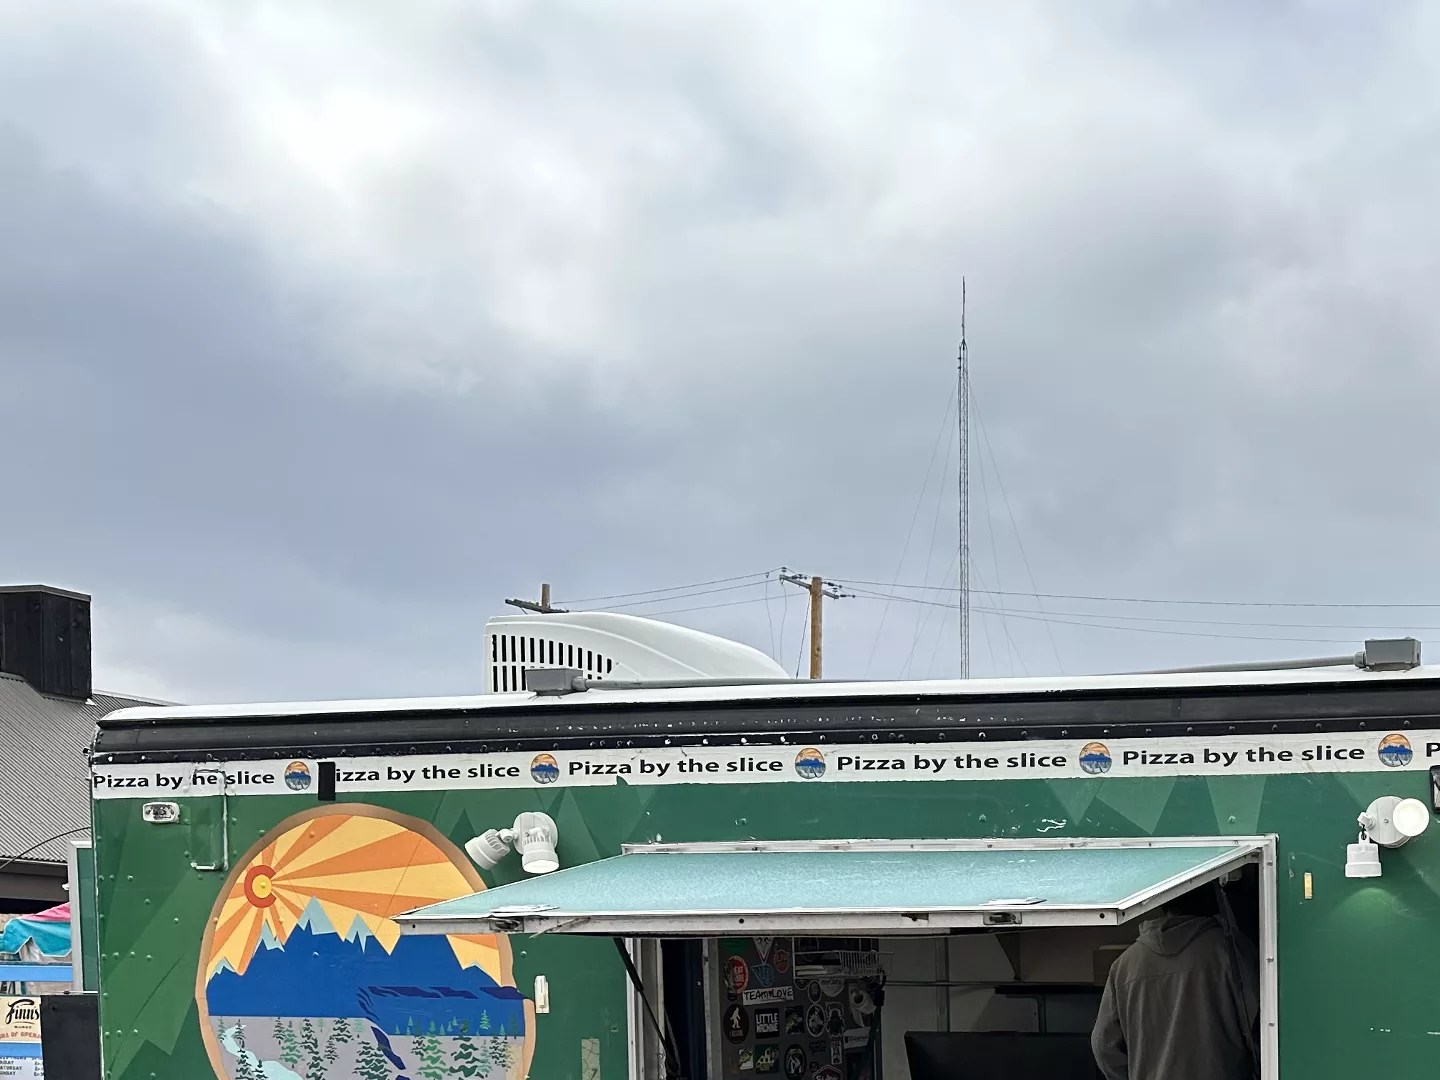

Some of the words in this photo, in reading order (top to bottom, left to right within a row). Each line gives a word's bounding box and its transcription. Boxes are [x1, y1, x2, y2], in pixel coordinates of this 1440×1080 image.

[837, 755, 905, 771] Pizza
[914, 754, 947, 773] by
[954, 753, 1000, 769] the
[1007, 752, 1067, 768] slice
[1123, 749, 1194, 765] Pizza
[1203, 748, 1238, 767] by
[1246, 747, 1293, 763] the
[1301, 745, 1365, 761] slice
[336, 768, 380, 782] izza
[387, 766, 415, 783] by
[423, 765, 461, 780] the
[468, 763, 520, 778] slice
[569, 760, 632, 775] Pizza
[640, 759, 671, 777] by
[678, 758, 720, 773] the
[726, 757, 783, 773] slice
[93, 774, 149, 788] Pizza
[156, 773, 183, 790] by
[191, 772, 218, 786] he
[226, 771, 275, 785] slice
